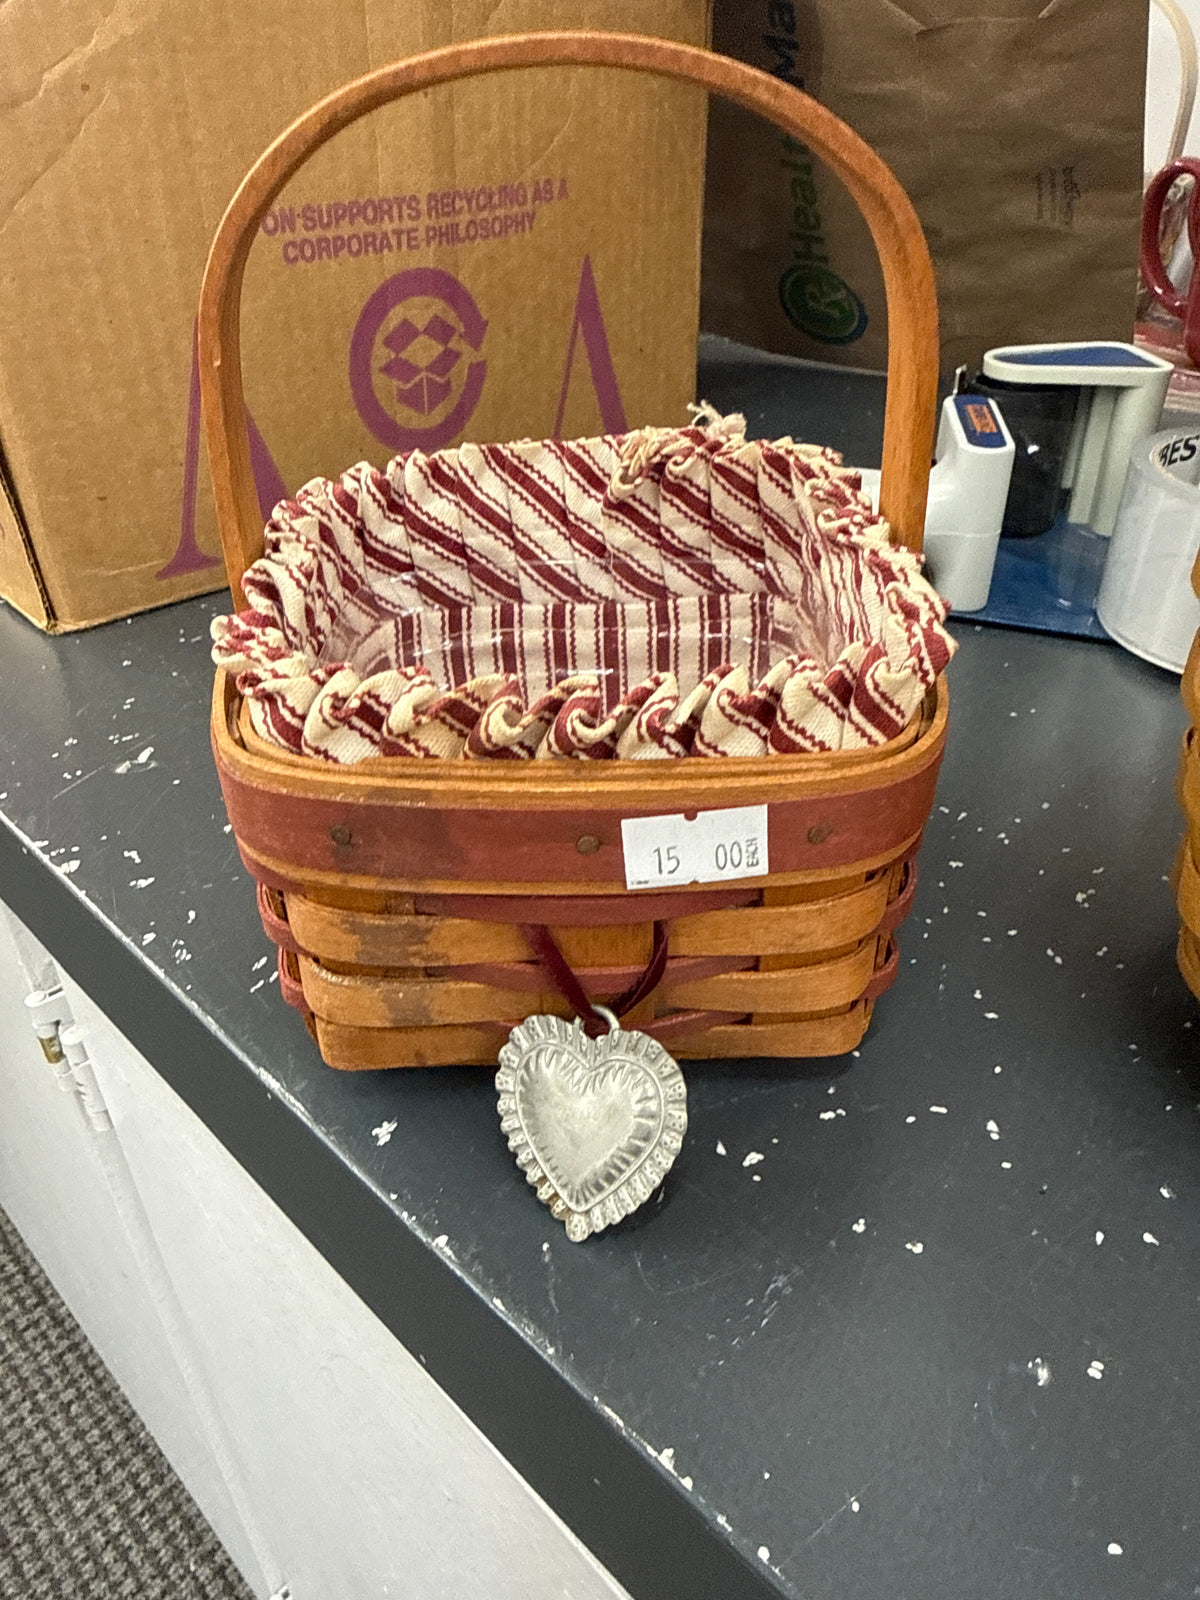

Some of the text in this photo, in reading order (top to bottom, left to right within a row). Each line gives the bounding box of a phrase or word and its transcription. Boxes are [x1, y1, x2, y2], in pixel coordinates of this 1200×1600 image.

[261, 176, 570, 237] ON SUPPORTS RECYCLING AS A
[282, 210, 537, 266] CORPORATE PHILOSOPHY
[653, 841, 743, 875] 15 00
